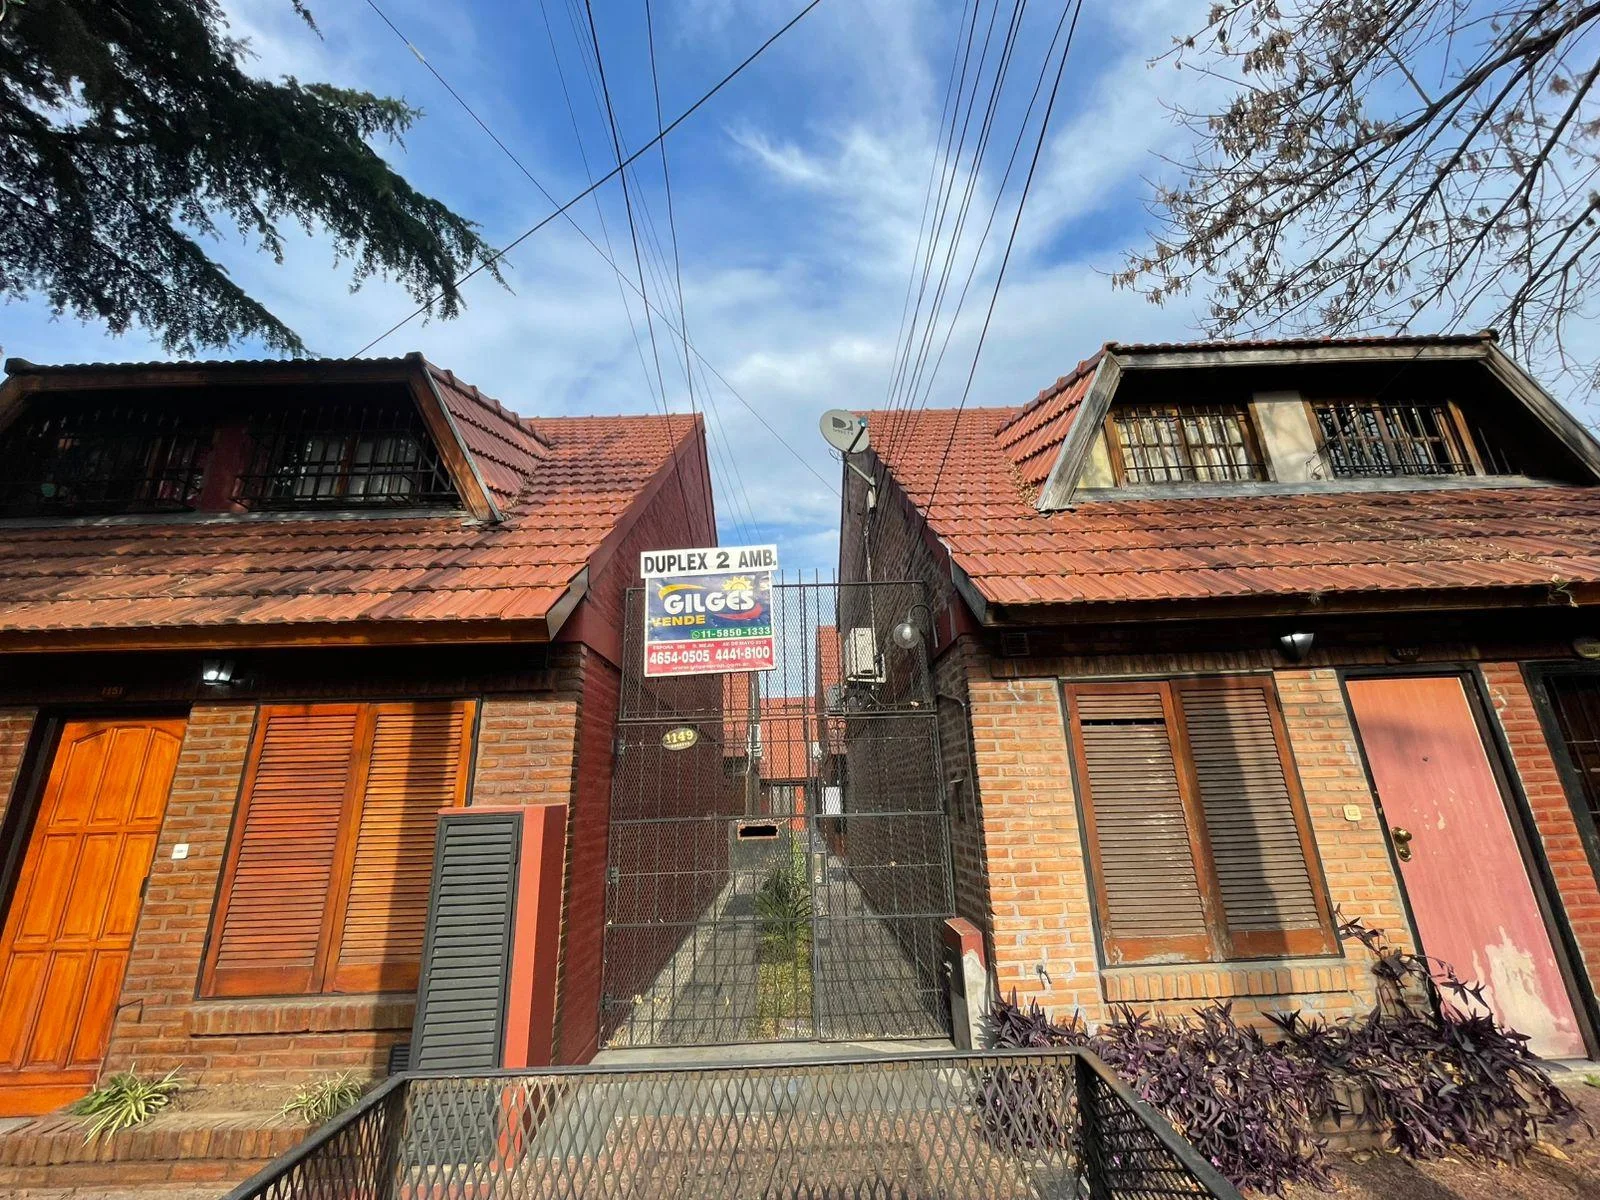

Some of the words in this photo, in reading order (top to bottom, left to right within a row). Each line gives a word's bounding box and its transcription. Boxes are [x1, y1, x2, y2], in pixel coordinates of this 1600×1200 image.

[644, 552, 708, 574] DUPLEX
[716, 551, 730, 569] 2
[738, 549, 777, 568] AMB.
[664, 590, 755, 615] GILGES
[651, 614, 706, 627] VENDE
[700, 627, 772, 639] 11-5850-1333
[649, 650, 710, 665] 4654-0505
[715, 646, 770, 661] 4441-8100
[665, 730, 694, 744] 1149
